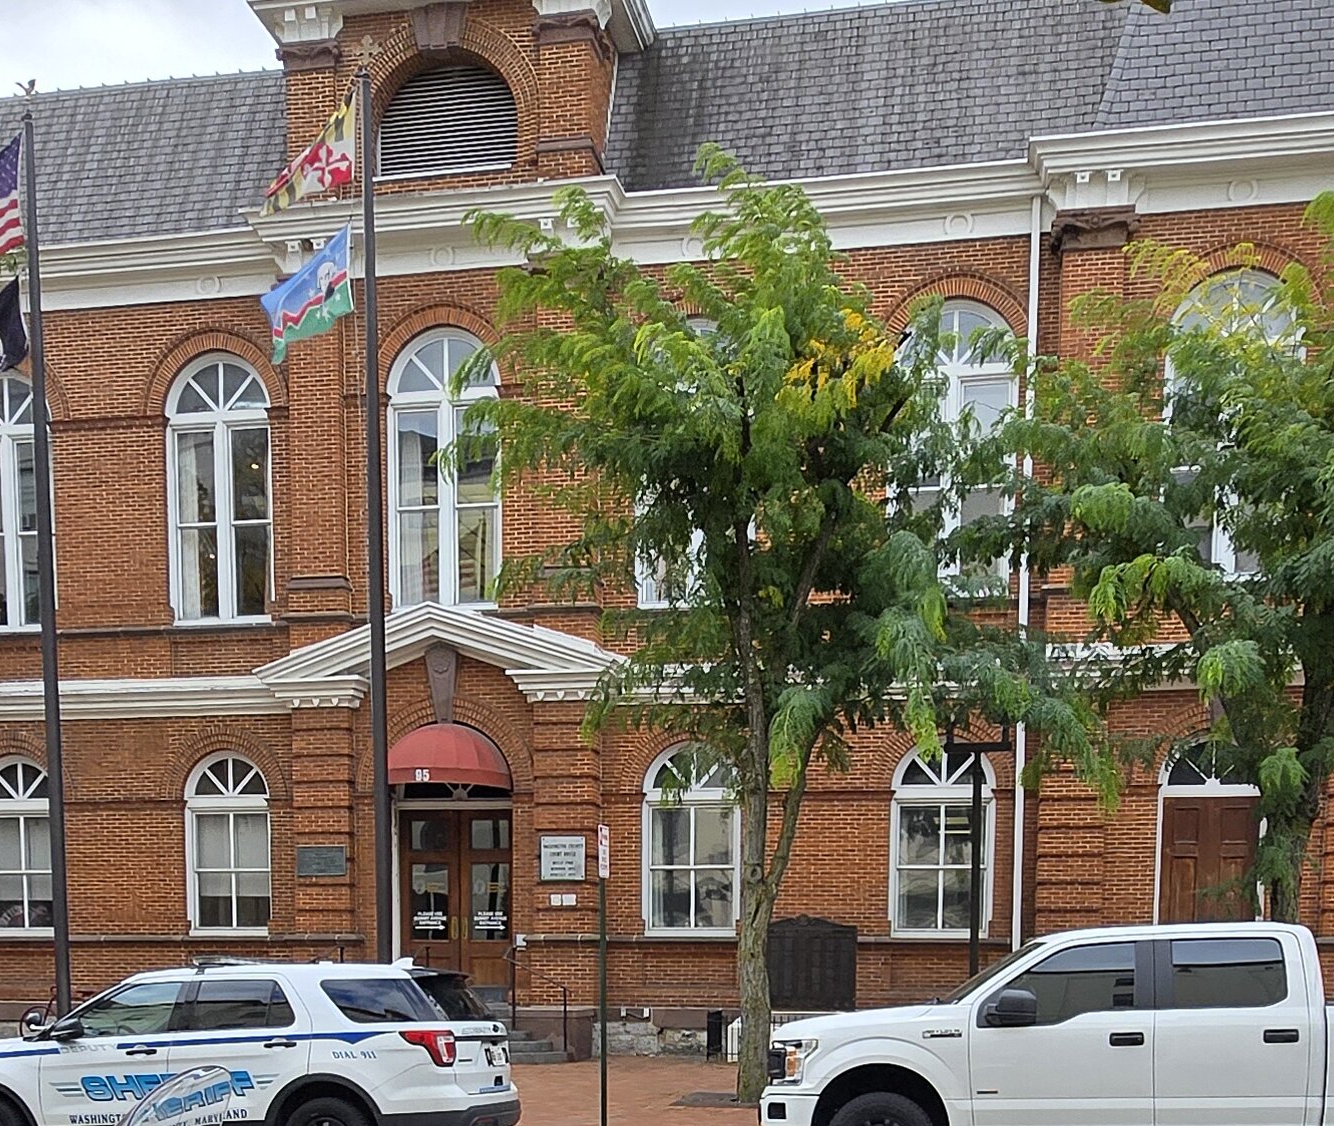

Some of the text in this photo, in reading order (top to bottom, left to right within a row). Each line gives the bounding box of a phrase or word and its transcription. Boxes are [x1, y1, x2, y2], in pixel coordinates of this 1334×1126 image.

[415, 769, 430, 782] 95
[60, 1043, 117, 1055] DEPUTY
[332, 1050, 378, 1060] DIAL 911
